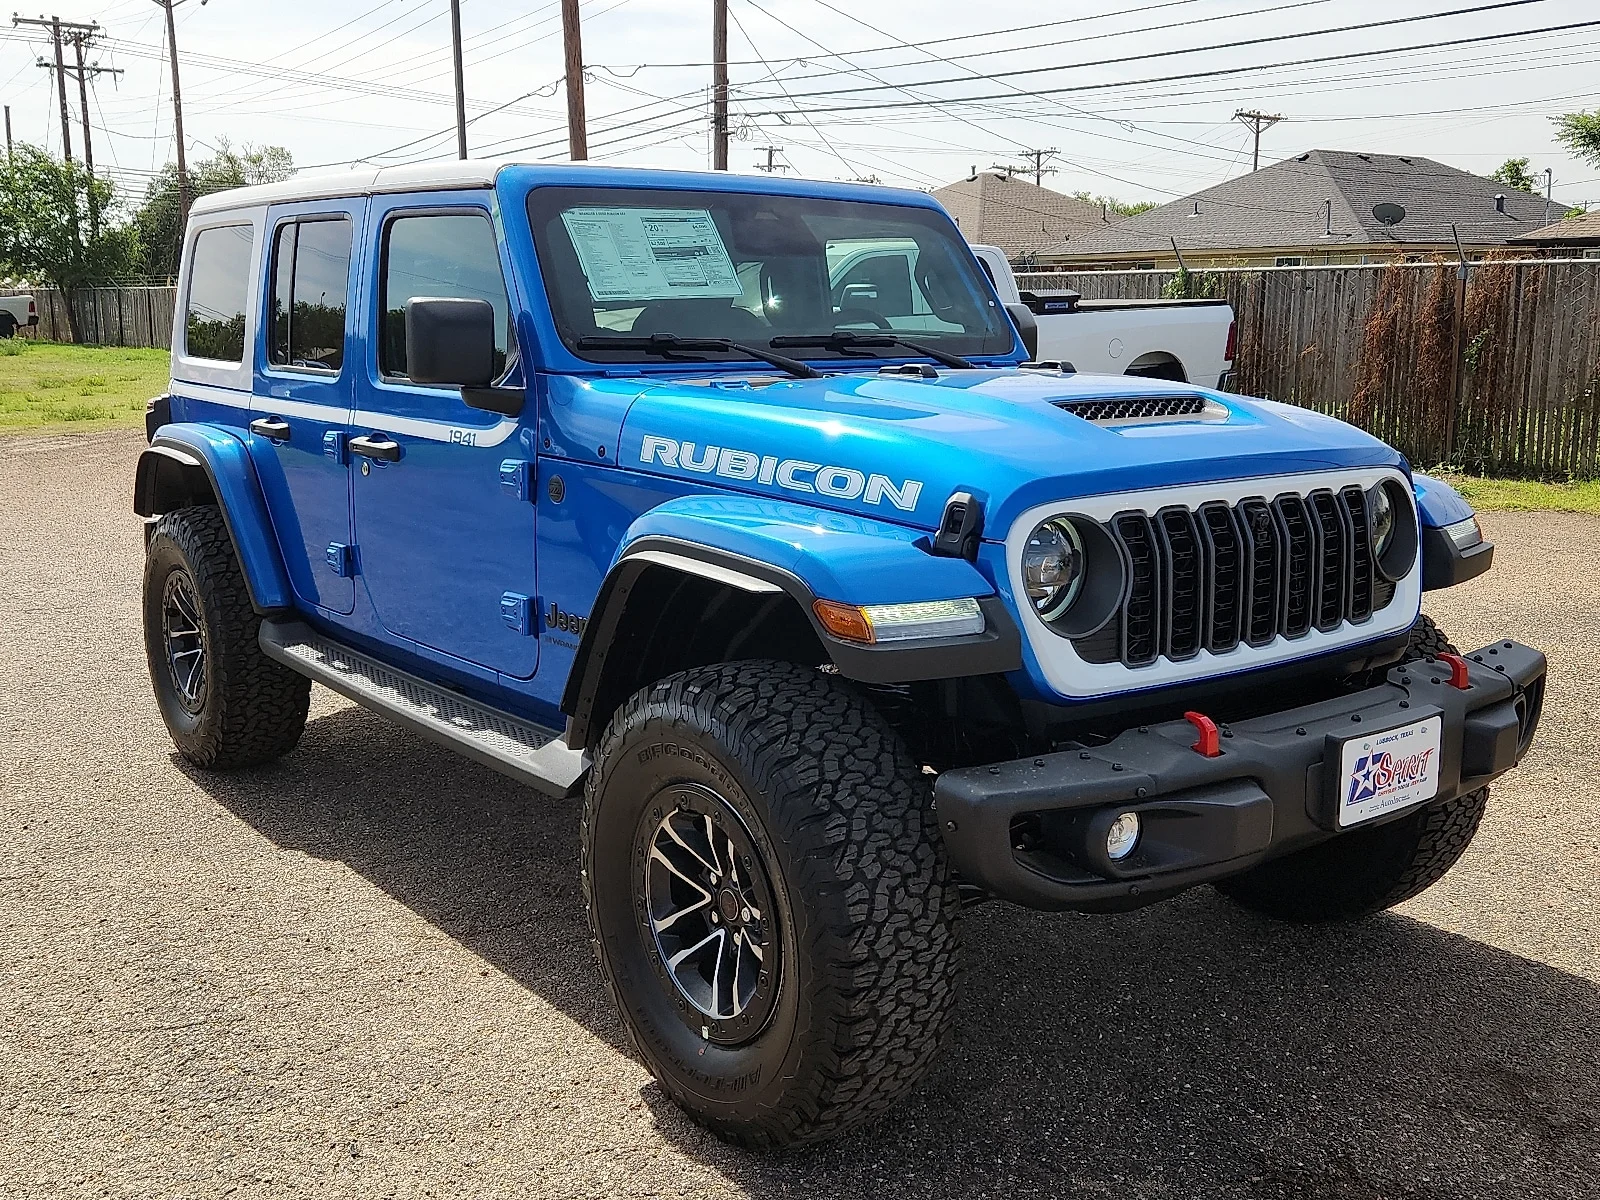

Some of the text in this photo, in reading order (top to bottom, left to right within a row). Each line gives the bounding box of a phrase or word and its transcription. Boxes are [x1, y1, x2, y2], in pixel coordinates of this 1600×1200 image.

[648, 223, 659, 232] 20
[449, 429, 477, 447] 1941
[639, 433, 924, 512] RUBICON
[1400, 729, 1414, 739] TEXAS
